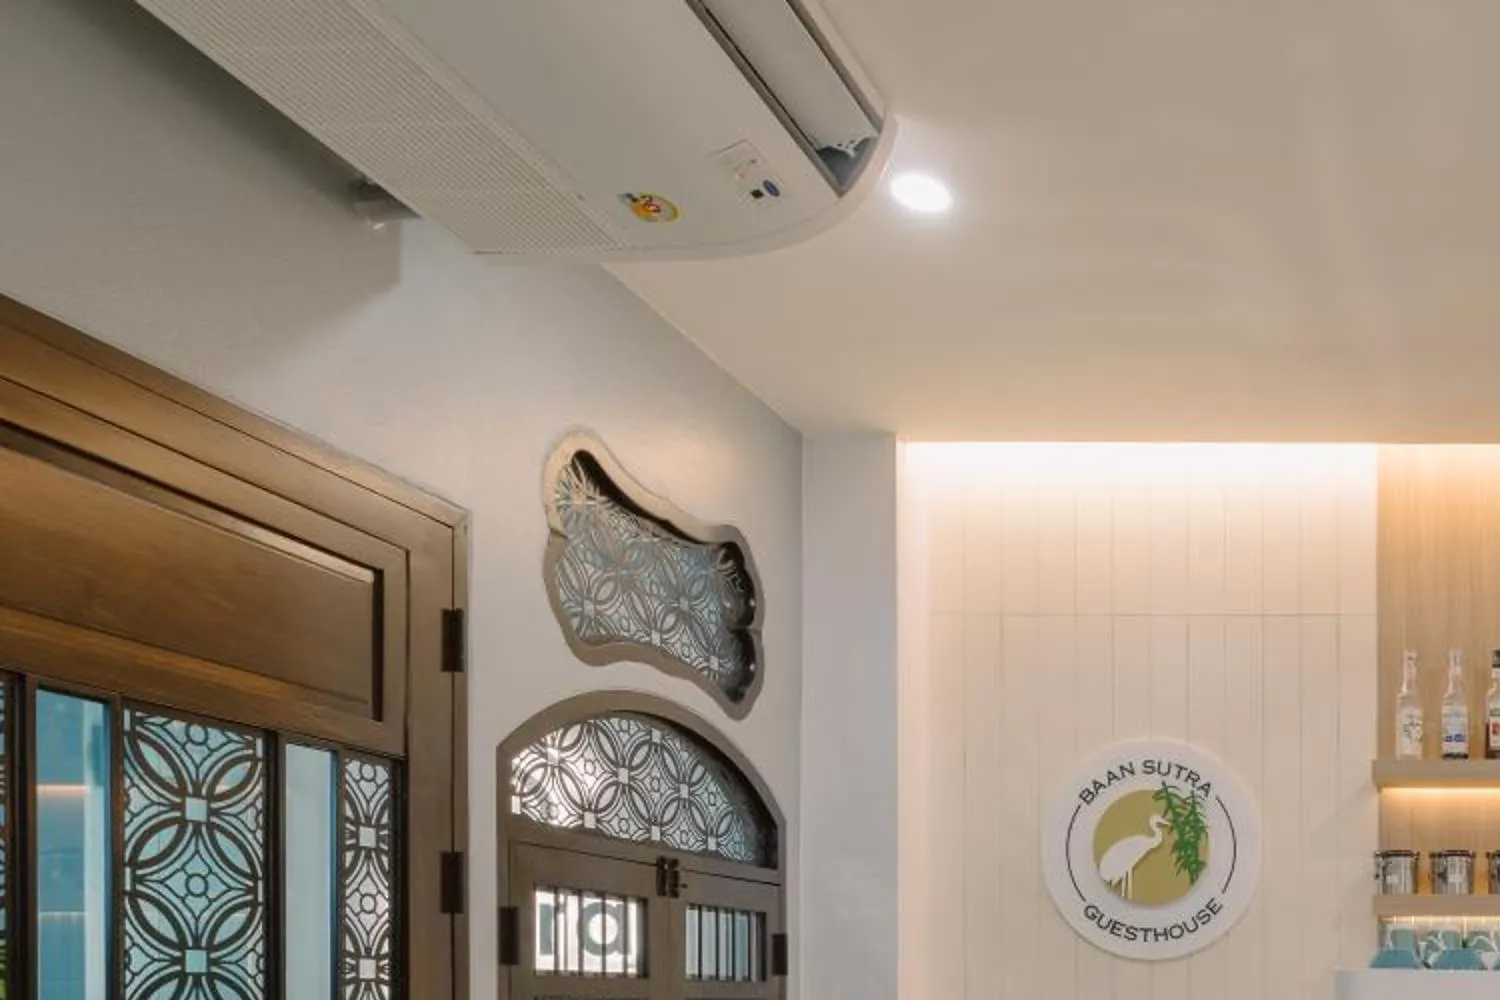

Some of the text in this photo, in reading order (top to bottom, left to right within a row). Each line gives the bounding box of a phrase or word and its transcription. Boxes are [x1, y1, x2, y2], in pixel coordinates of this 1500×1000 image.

[1079, 759, 1212, 804] BAAN SUTRA
[1083, 898, 1223, 942] GUESTHOUSE
